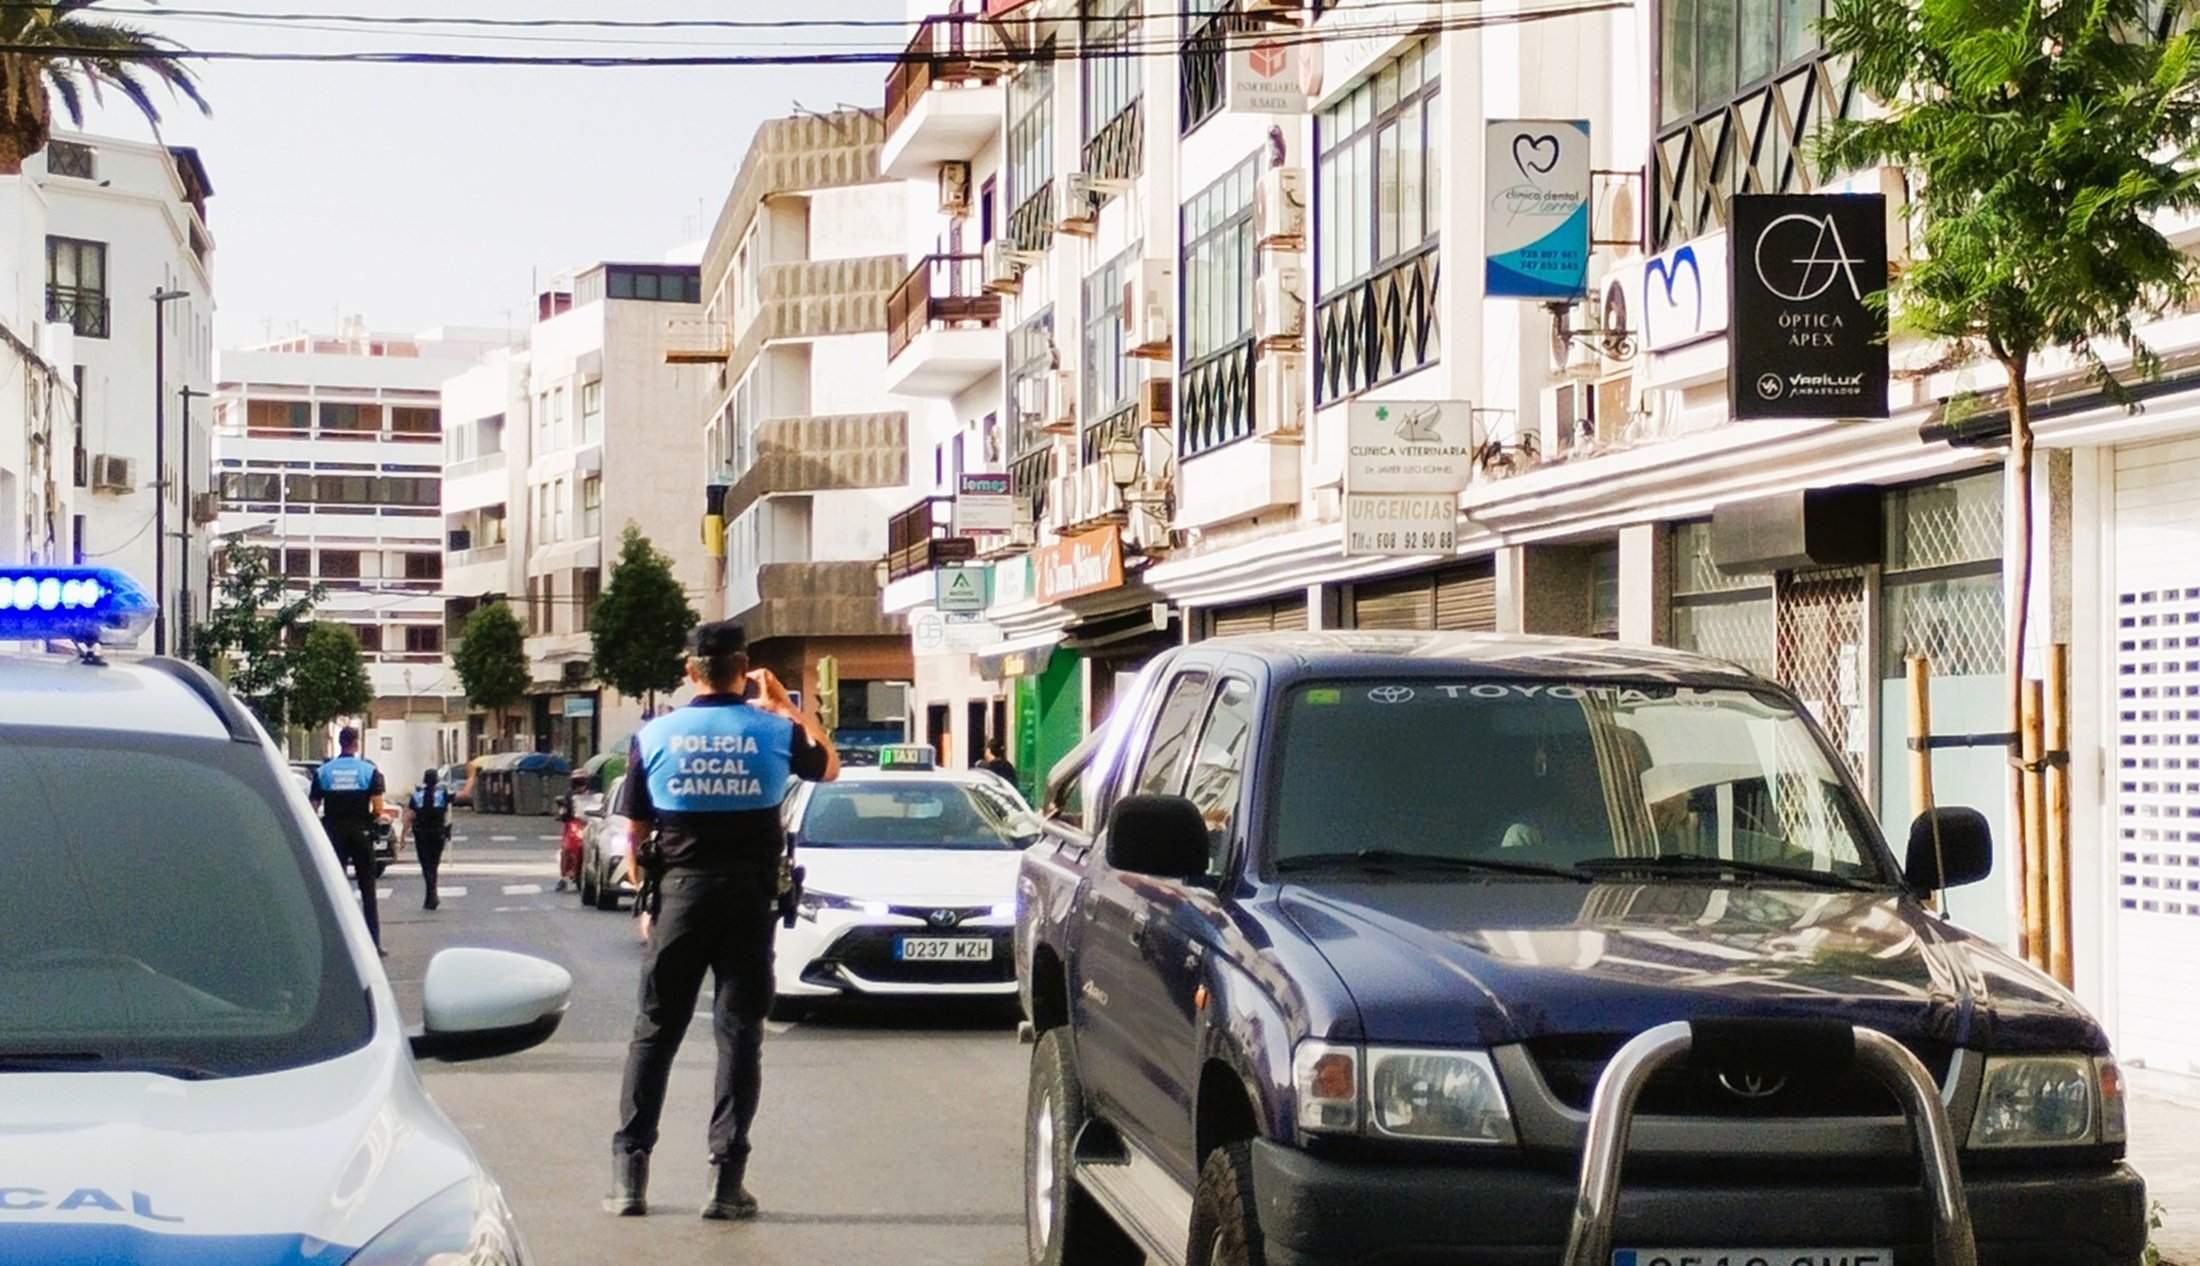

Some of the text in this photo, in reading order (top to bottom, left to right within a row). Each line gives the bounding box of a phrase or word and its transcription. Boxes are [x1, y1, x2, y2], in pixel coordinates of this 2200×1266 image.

[1543, 189, 1579, 201] dental
[1778, 311, 1844, 328] ÓPTICA
[1399, 446, 1468, 456] VETERINARIA
[1351, 499, 1453, 519] URGENCIAS
[1404, 531, 1417, 549] 92
[1434, 684, 1652, 701] TOYOTA
[893, 750, 918, 763] TAXI
[679, 758, 751, 774] LOCAL
[667, 778, 762, 796] CANARIA
[904, 941, 988, 958] 0237 MZH
